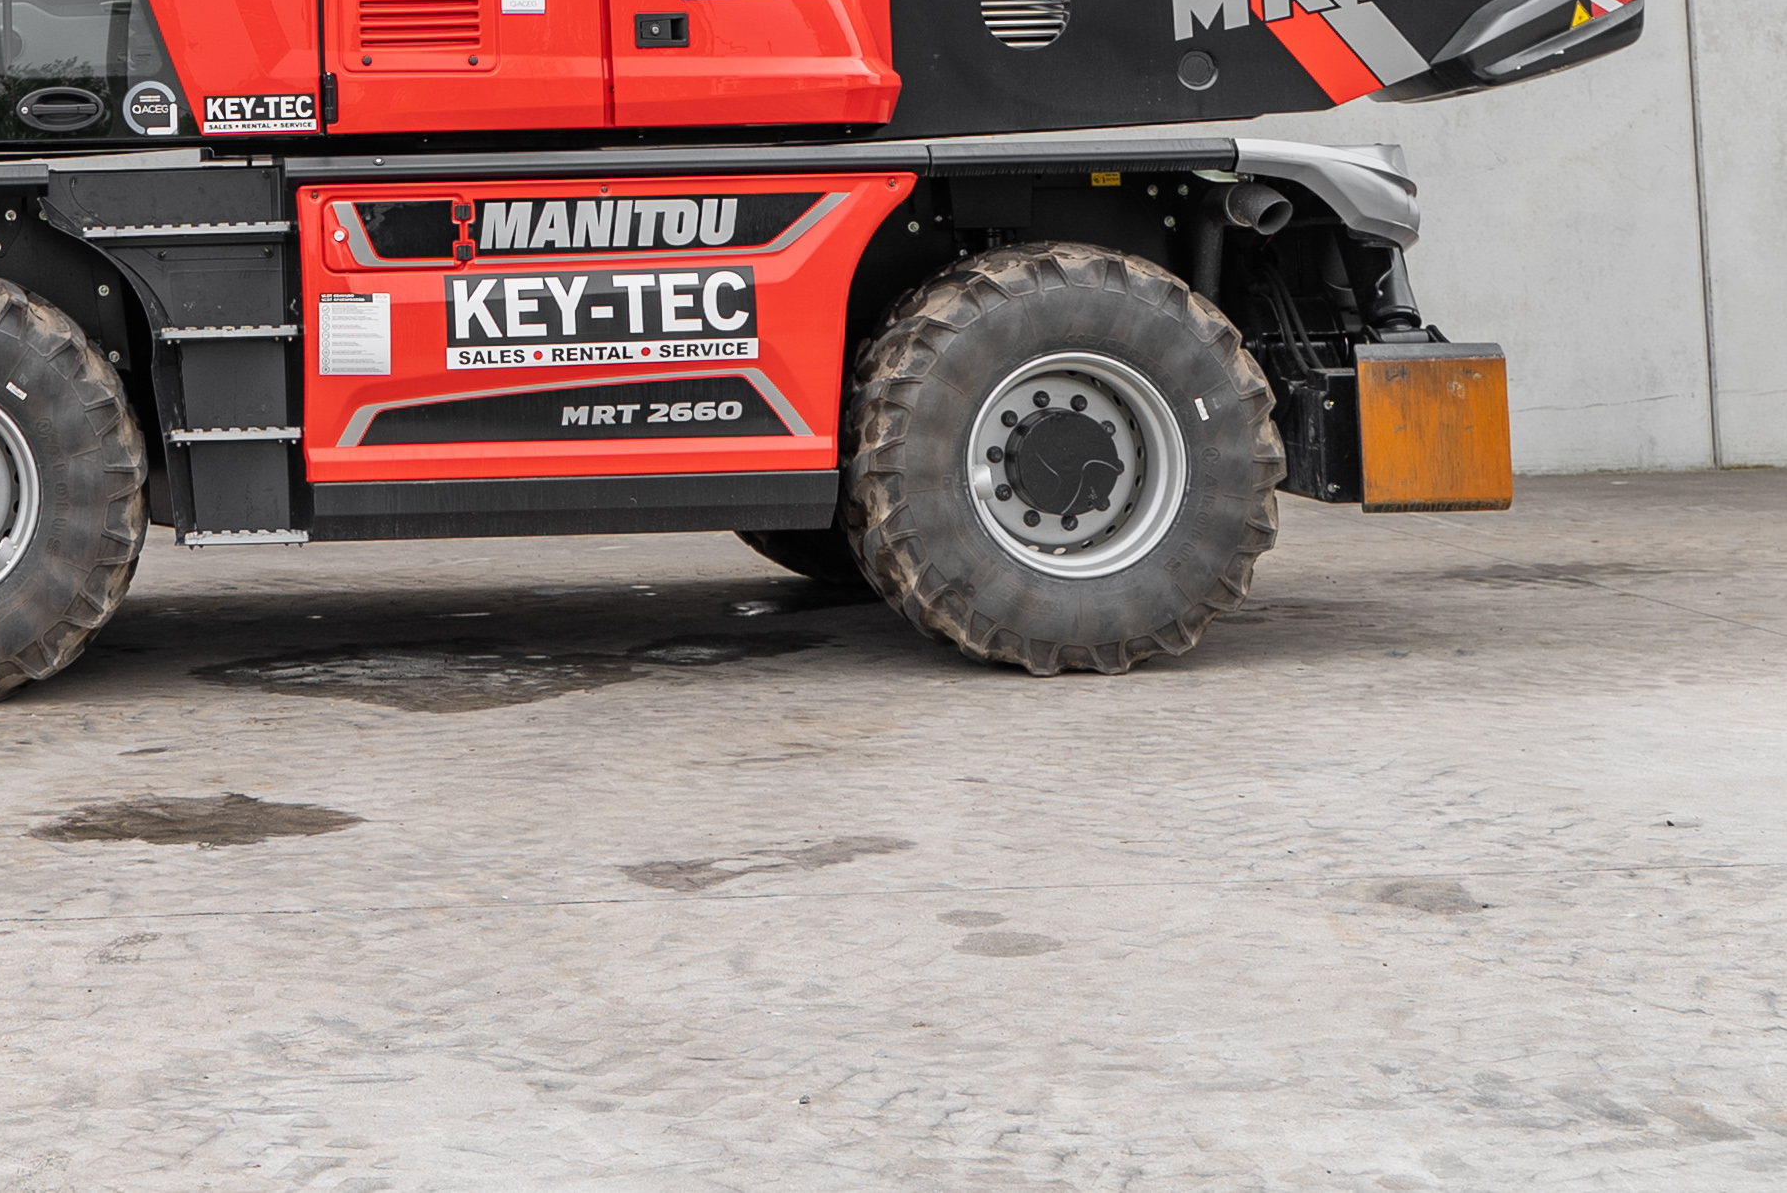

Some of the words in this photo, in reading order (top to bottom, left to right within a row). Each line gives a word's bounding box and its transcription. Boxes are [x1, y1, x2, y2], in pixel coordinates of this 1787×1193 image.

[206, 95, 313, 120] KEY-TEC
[479, 198, 738, 249] MANITOU
[452, 270, 750, 339] KEY-TEC
[458, 349, 526, 366] SALES
[551, 346, 634, 363] RENTAL
[659, 342, 749, 359] SERVICE
[561, 404, 640, 426] MRT
[647, 401, 743, 423] 2660
